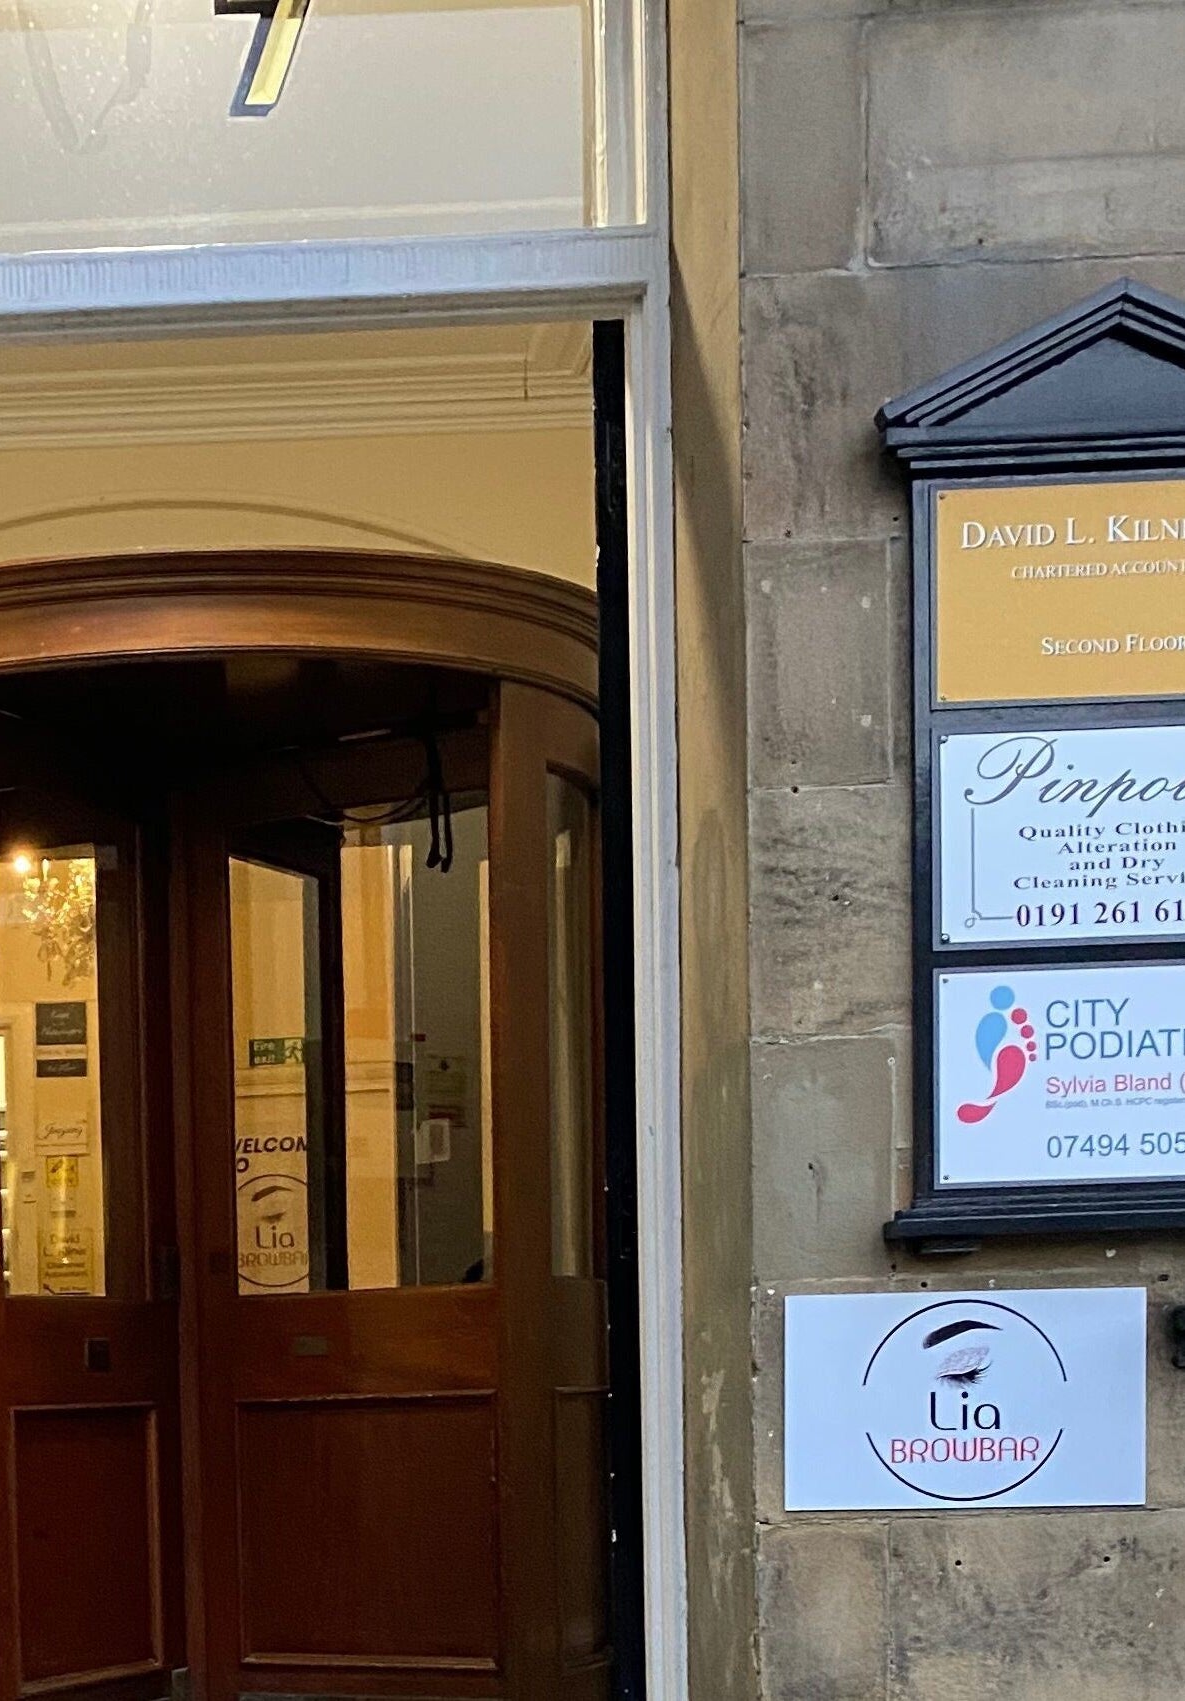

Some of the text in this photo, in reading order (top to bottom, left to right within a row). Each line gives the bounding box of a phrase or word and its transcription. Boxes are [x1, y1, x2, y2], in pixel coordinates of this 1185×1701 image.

[960, 521, 1056, 549] DAVID
[1064, 517, 1096, 546] L.
[1011, 562, 1108, 579] CHARTERED
[1041, 636, 1121, 657] SECOND
[1018, 820, 1185, 842] Quality Clothi
[1058, 840, 1177, 855] Alteration
[1069, 856, 1165, 871] and Dry
[1013, 872, 1185, 890] Cleaning Servi
[1016, 899, 1185, 927] 0191 261 61
[1046, 998, 1130, 1028] CITY
[1046, 1028, 1185, 1061] PODIAT
[1046, 1076, 1107, 1098] Sylvia
[1115, 1073, 1172, 1092] Bland
[1047, 1131, 1185, 1158] 07494 505
[255, 1224, 295, 1249] Lia
[930, 1391, 1001, 1431] Lia
[891, 1436, 1039, 1464] BROWBAR
